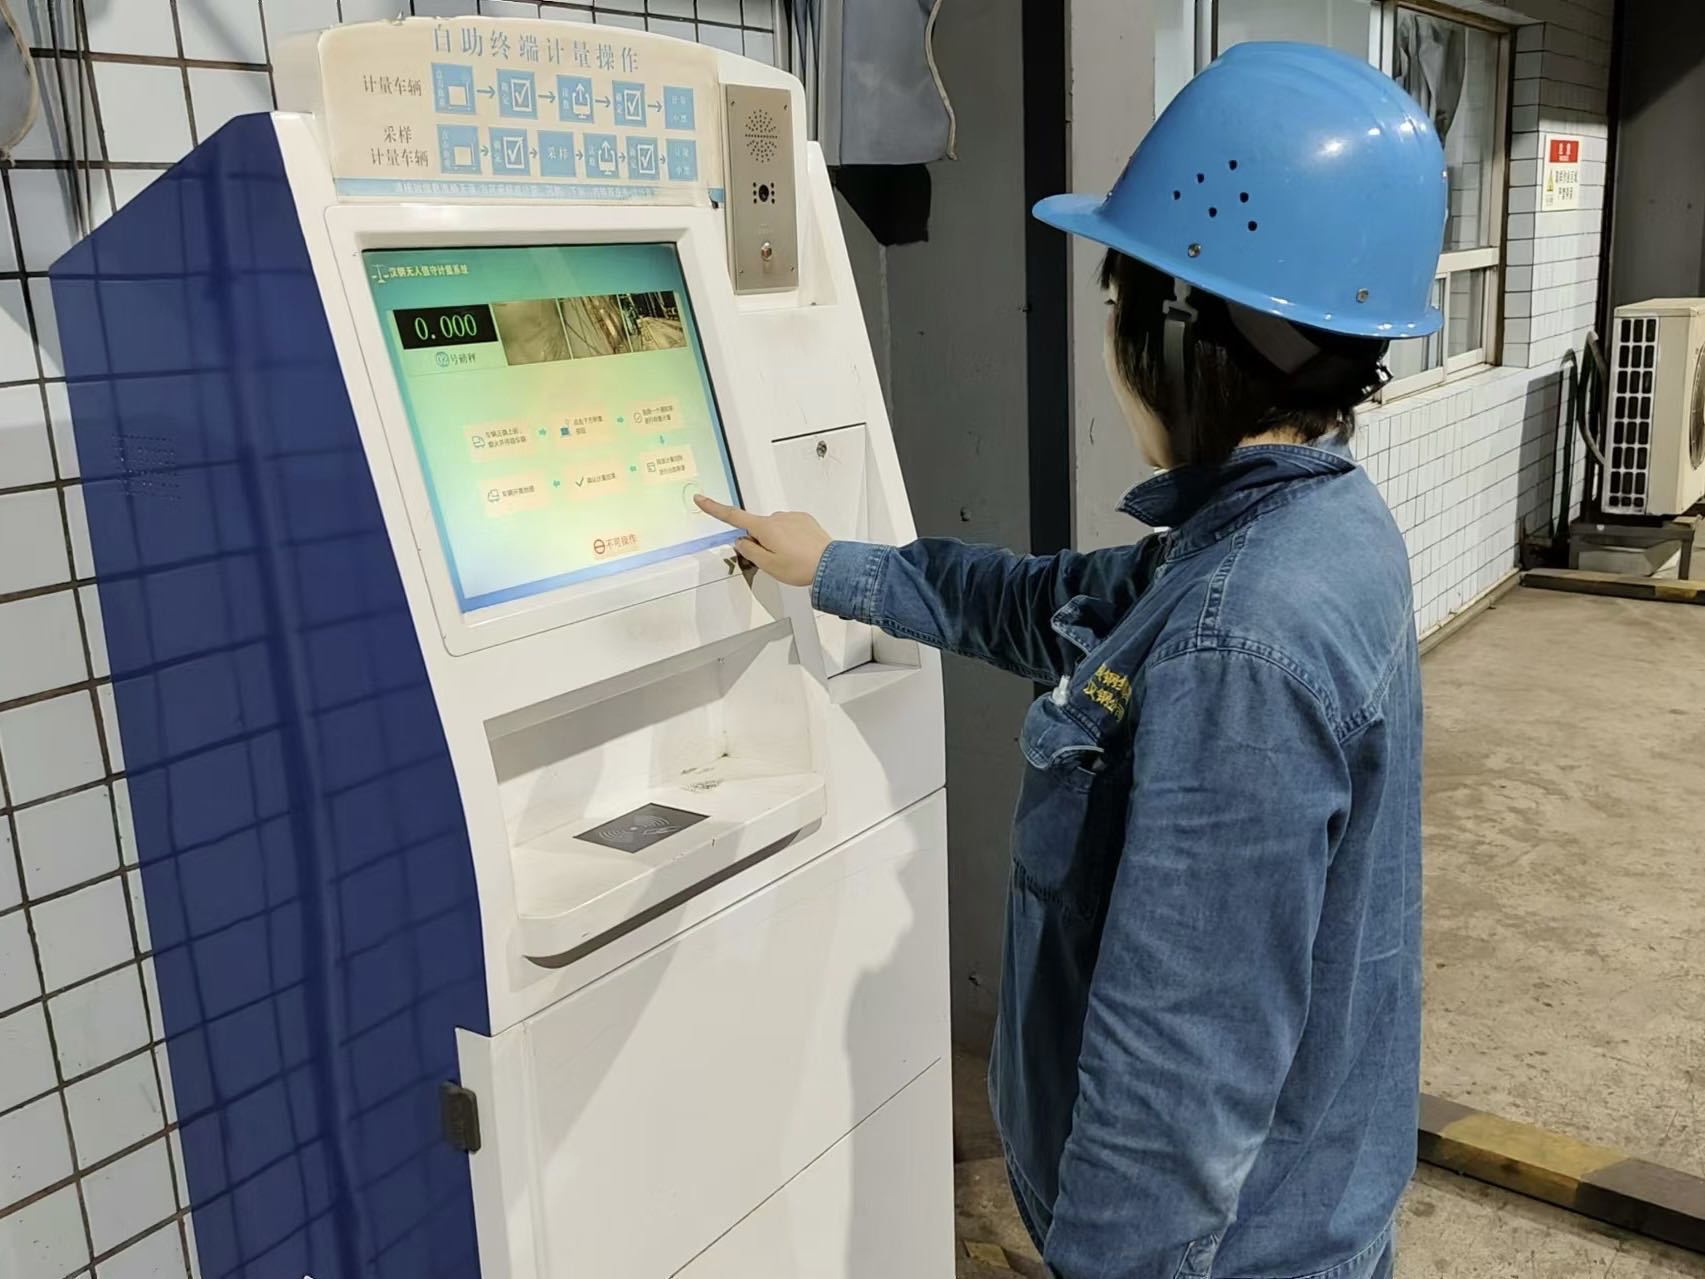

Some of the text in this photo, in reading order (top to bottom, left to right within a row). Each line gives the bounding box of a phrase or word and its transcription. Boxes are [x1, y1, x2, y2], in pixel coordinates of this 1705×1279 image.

[433, 24, 639, 72] 自助终端计量操作
[362, 74, 423, 98] 计量车辆
[383, 124, 413, 144] 采样
[370, 147, 429, 168] 计量车辆
[414, 313, 477, 340] 0.000
